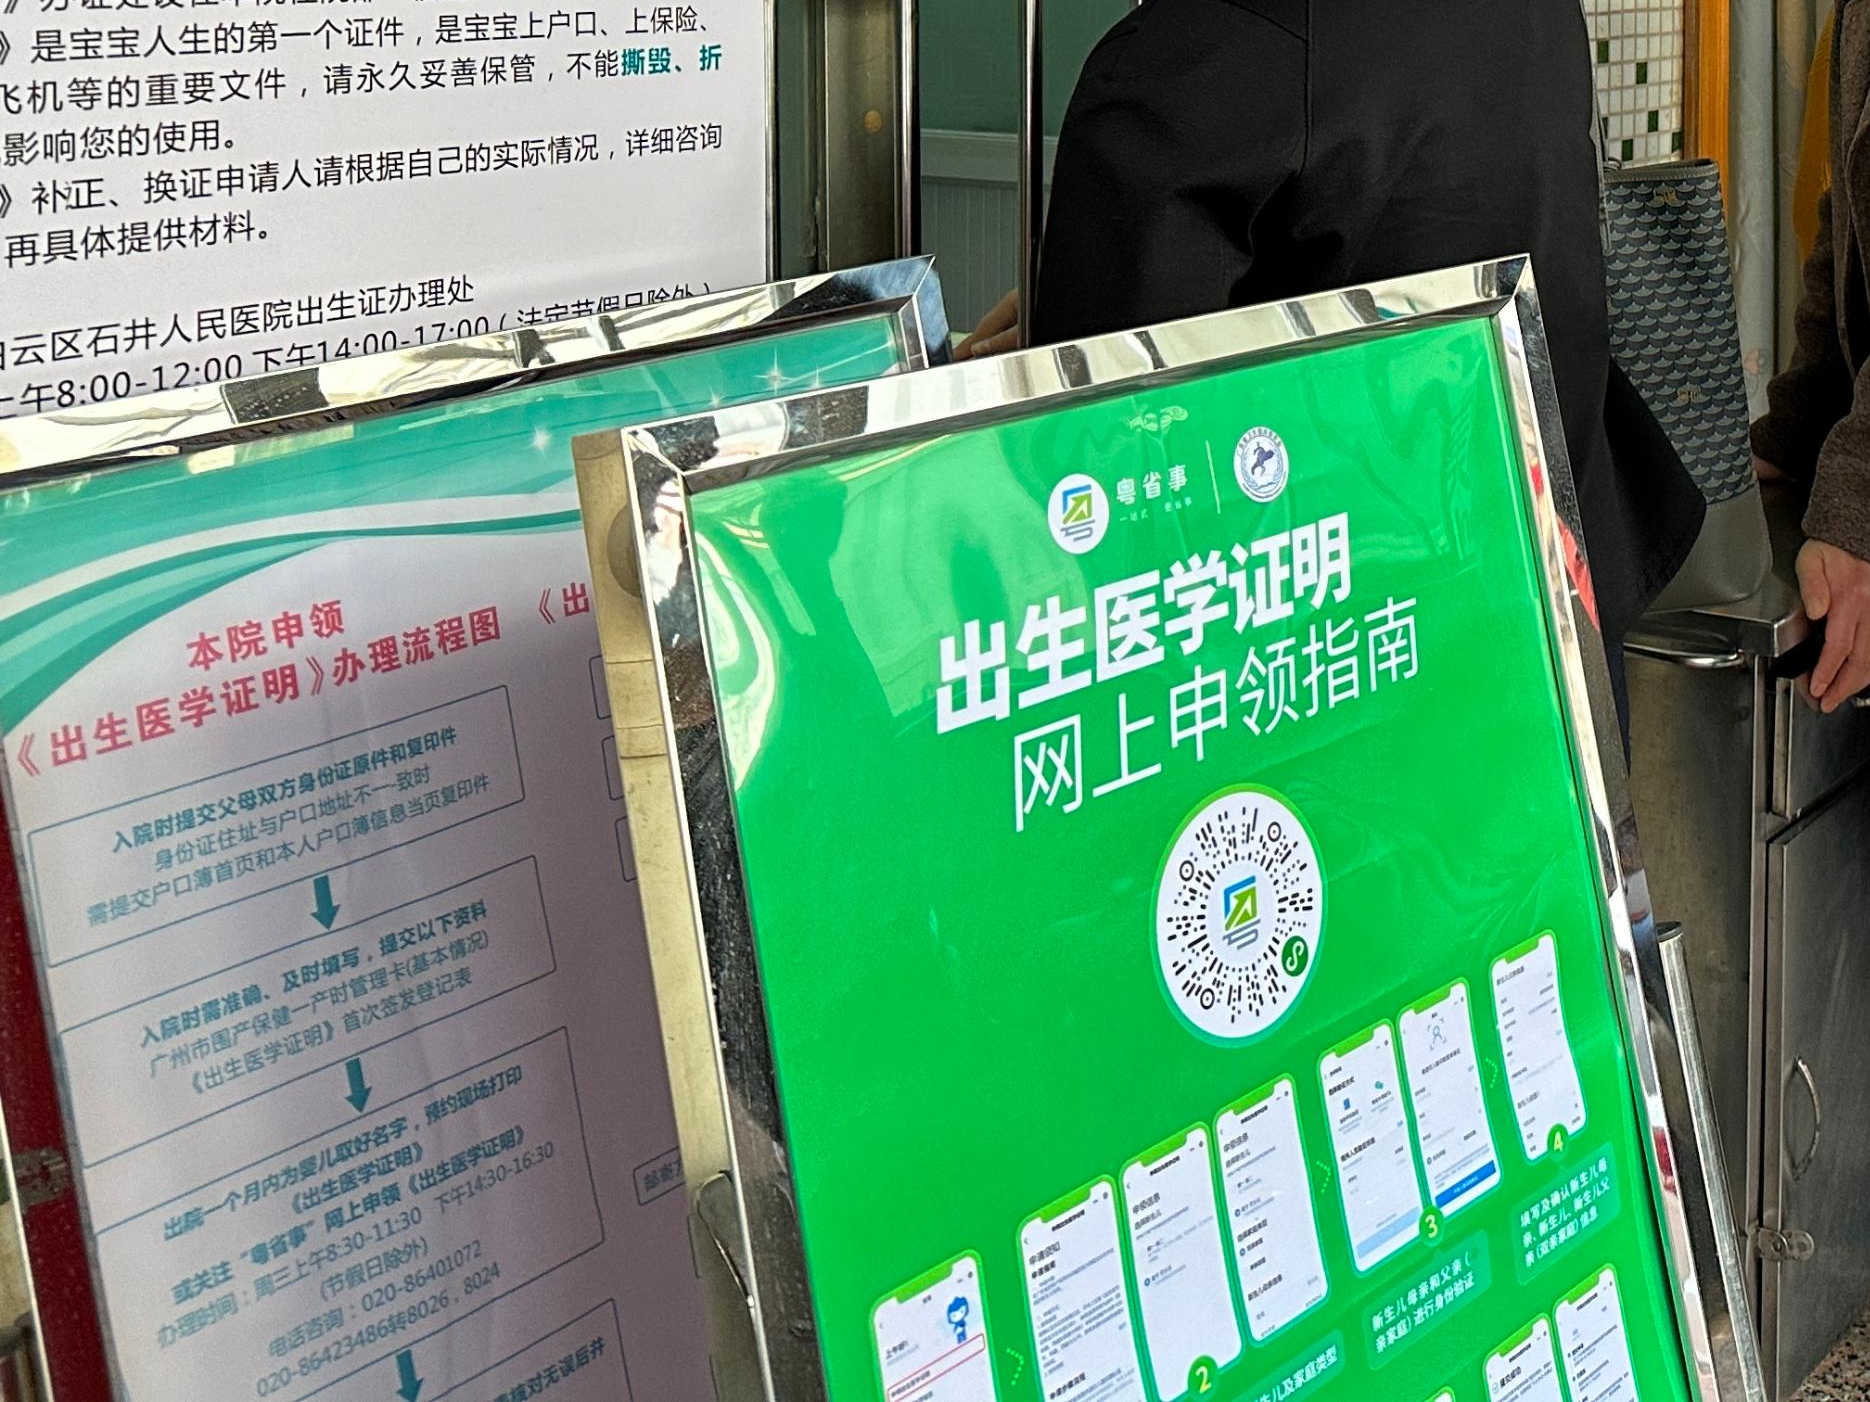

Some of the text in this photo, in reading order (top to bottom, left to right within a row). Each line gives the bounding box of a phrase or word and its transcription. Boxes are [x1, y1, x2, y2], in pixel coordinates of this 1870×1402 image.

[5, 209, 267, 269] 再具体提供材料。
[0, 274, 474, 371] 云区石井人民医院出生证办理处
[1116, 464, 1188, 505] 粤省事
[186, 599, 346, 673] 本院申领
[935, 511, 1352, 735] 出生医学证明
[16, 606, 501, 777] 《出生医学证明》办理流程图
[1013, 595, 1419, 833] 网上申领指南
[112, 725, 458, 854] 入院时提交父母双方身份证原件和复印件
[1553, 1130, 1563, 1153] 4
[1424, 1213, 1438, 1239] 3
[1195, 1365, 1211, 1394] 2
[1253, 1344, 1338, 1402] 生儿及家庭类型
